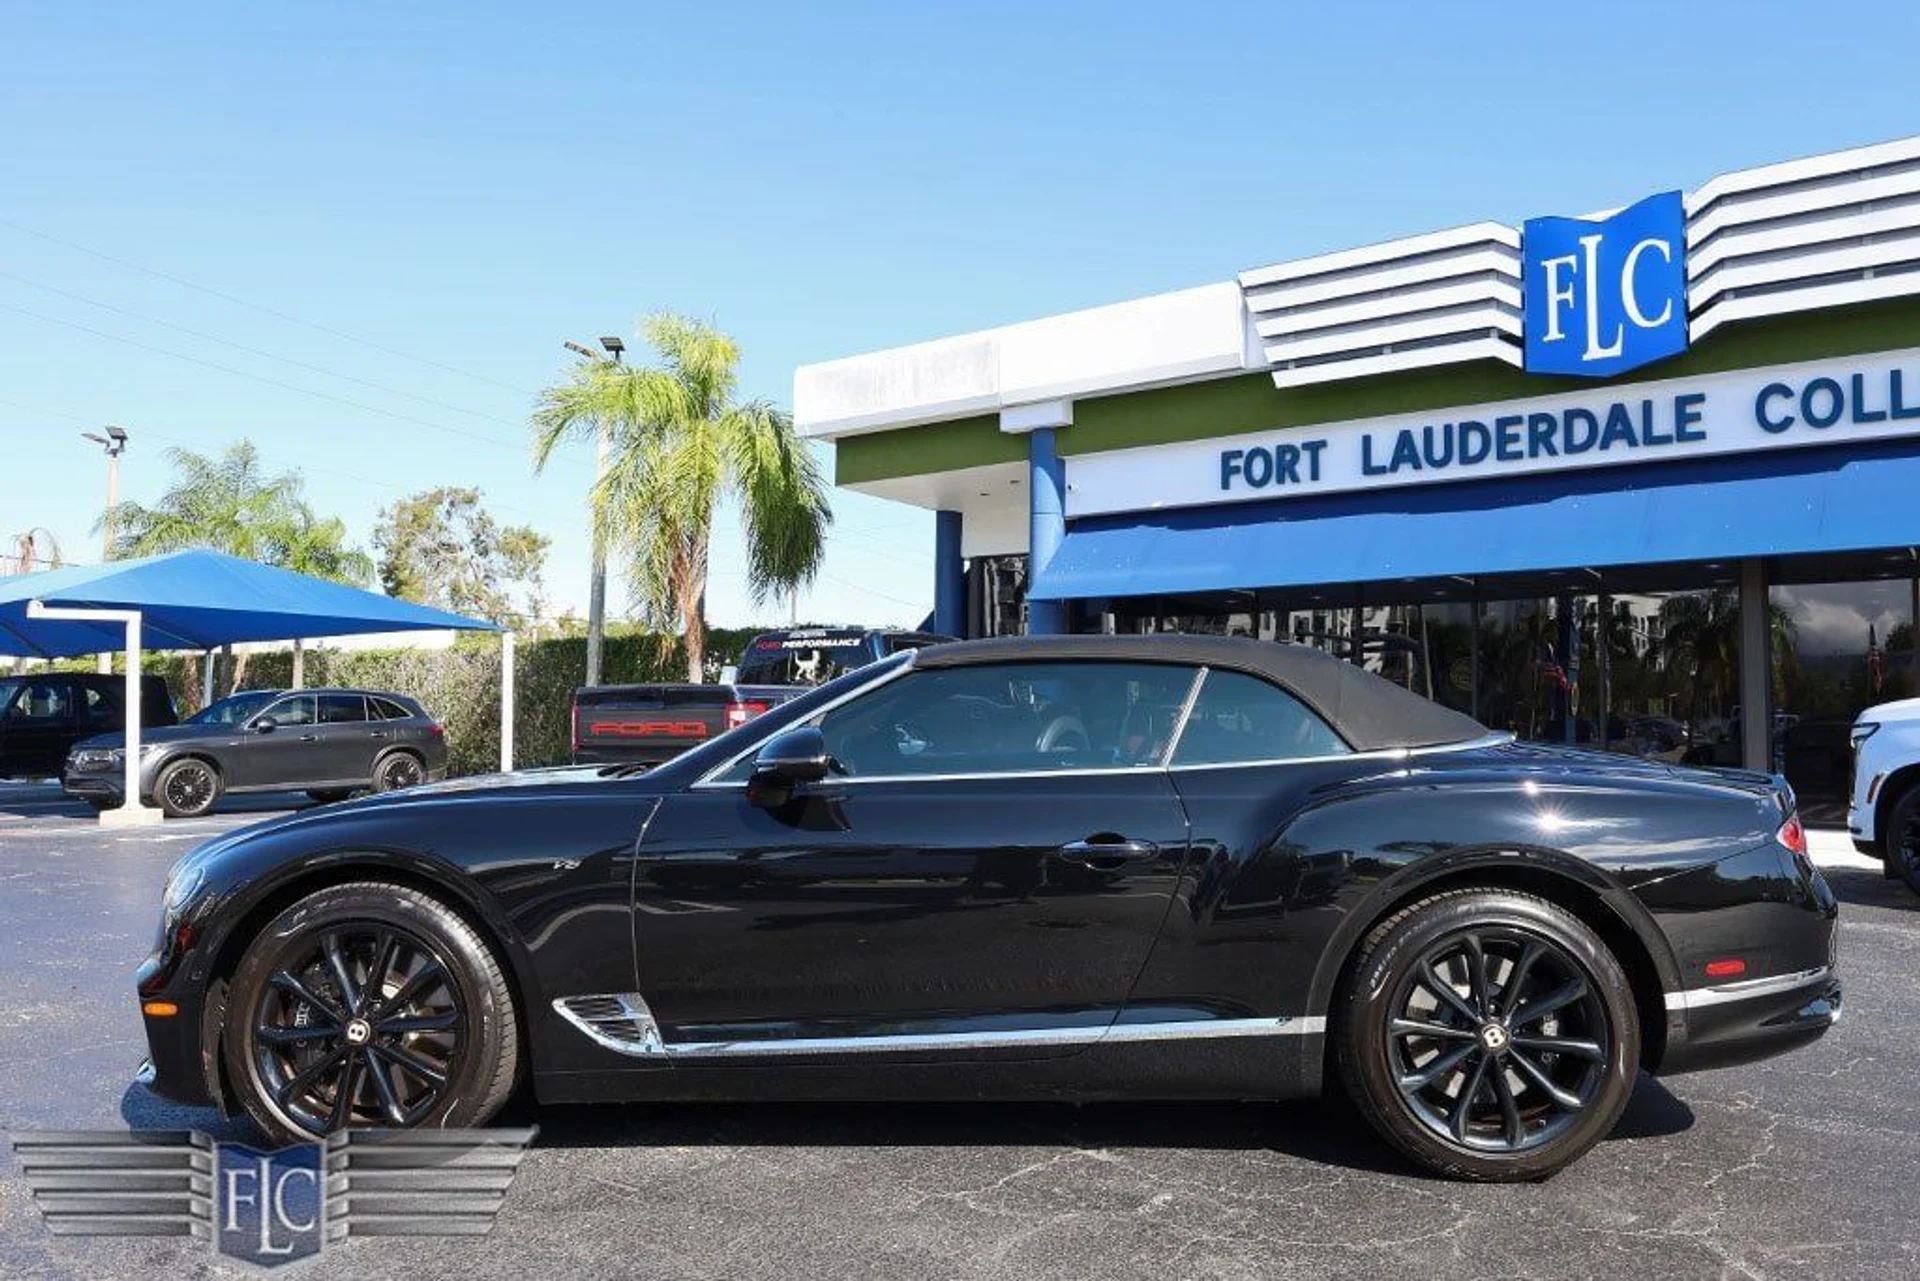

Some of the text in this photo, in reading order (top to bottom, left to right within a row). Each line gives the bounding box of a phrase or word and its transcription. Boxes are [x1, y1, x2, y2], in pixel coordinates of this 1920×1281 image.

[1541, 233, 1672, 362] FLC
[1221, 369, 1920, 490] FORT LAUDERDALE COLL
[756, 639, 861, 650] FORD PERFORMANCE
[591, 721, 707, 738] FORD
